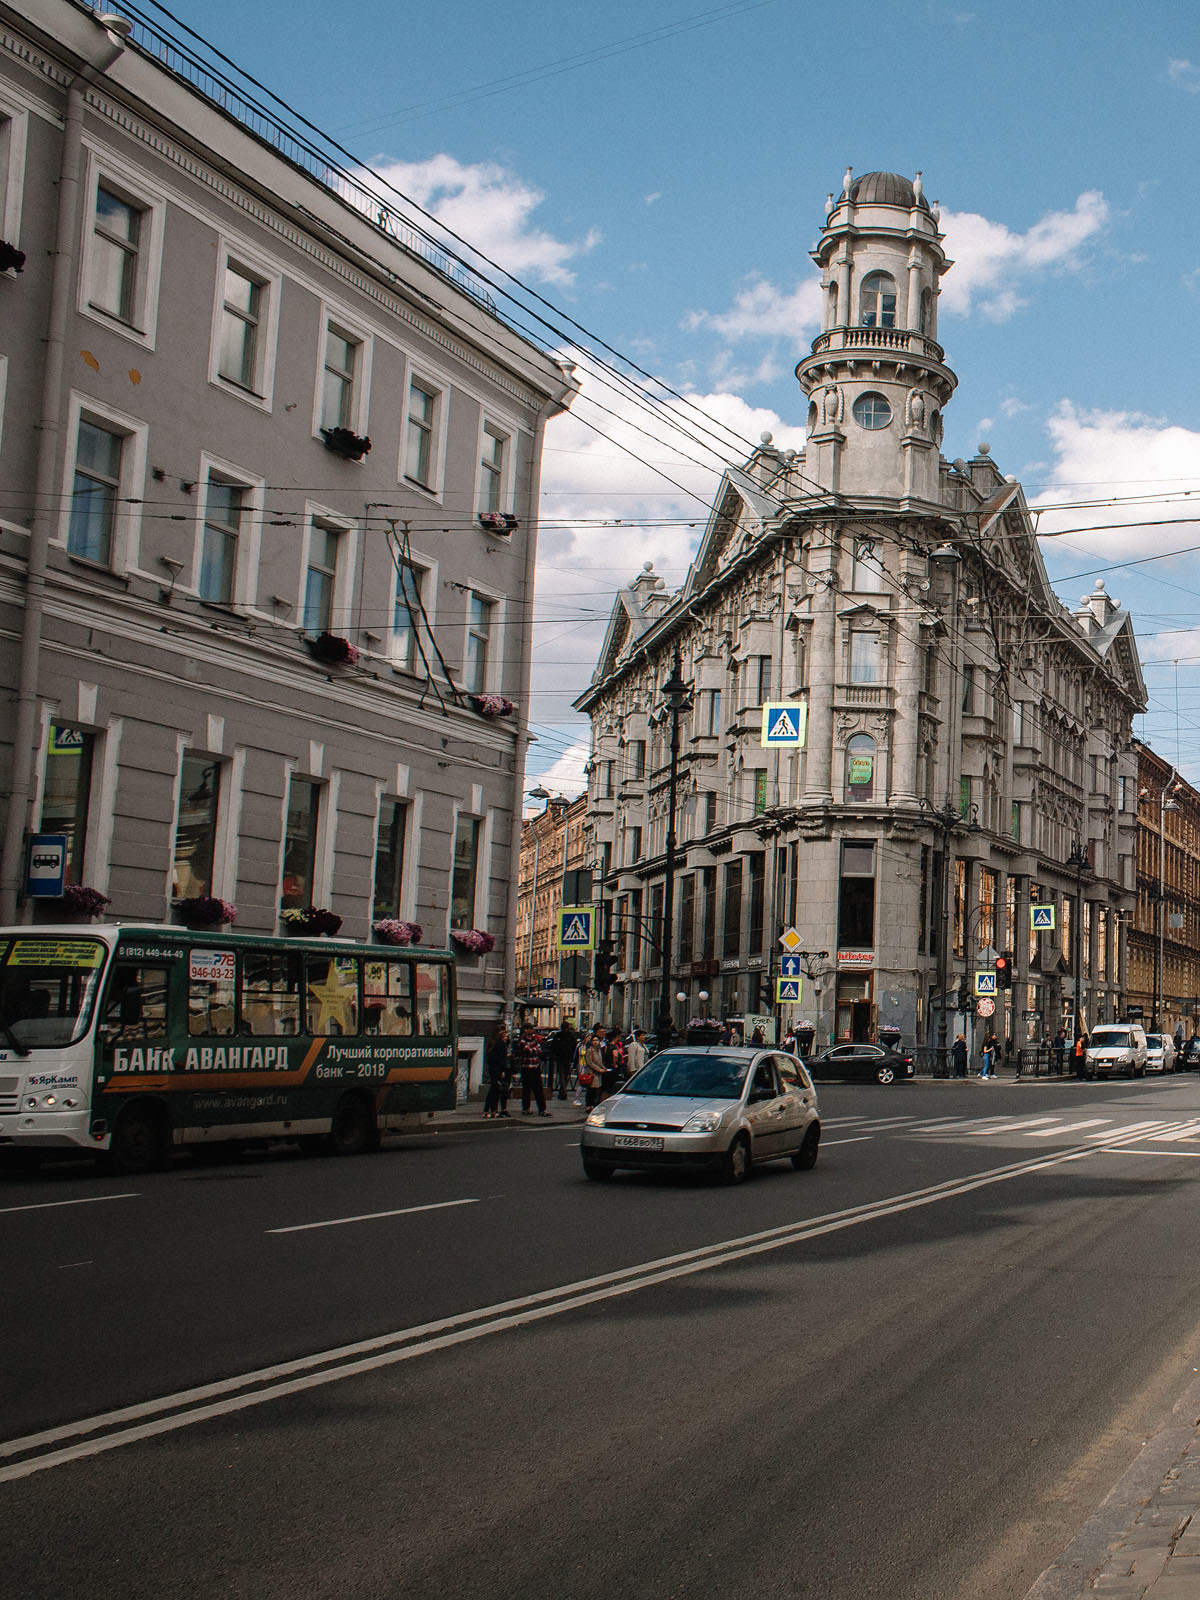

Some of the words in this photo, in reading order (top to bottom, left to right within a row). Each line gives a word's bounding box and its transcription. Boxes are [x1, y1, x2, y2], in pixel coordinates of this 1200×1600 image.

[126, 947, 144, 958] (812)
[146, 948, 184, 959] 449-44-49
[191, 967, 235, 979] 946-03-23
[113, 1046, 176, 1072] БАНК
[184, 1046, 289, 1071] АВАНГАРД
[326, 1044, 373, 1062] Лучший
[373, 1044, 453, 1061] корпоративный
[315, 1063, 344, 1079] банк
[357, 1063, 386, 1078] 2018
[38, 1075, 78, 1085] ЯрКамп
[193, 1093, 289, 1110] www.avangard.ru
